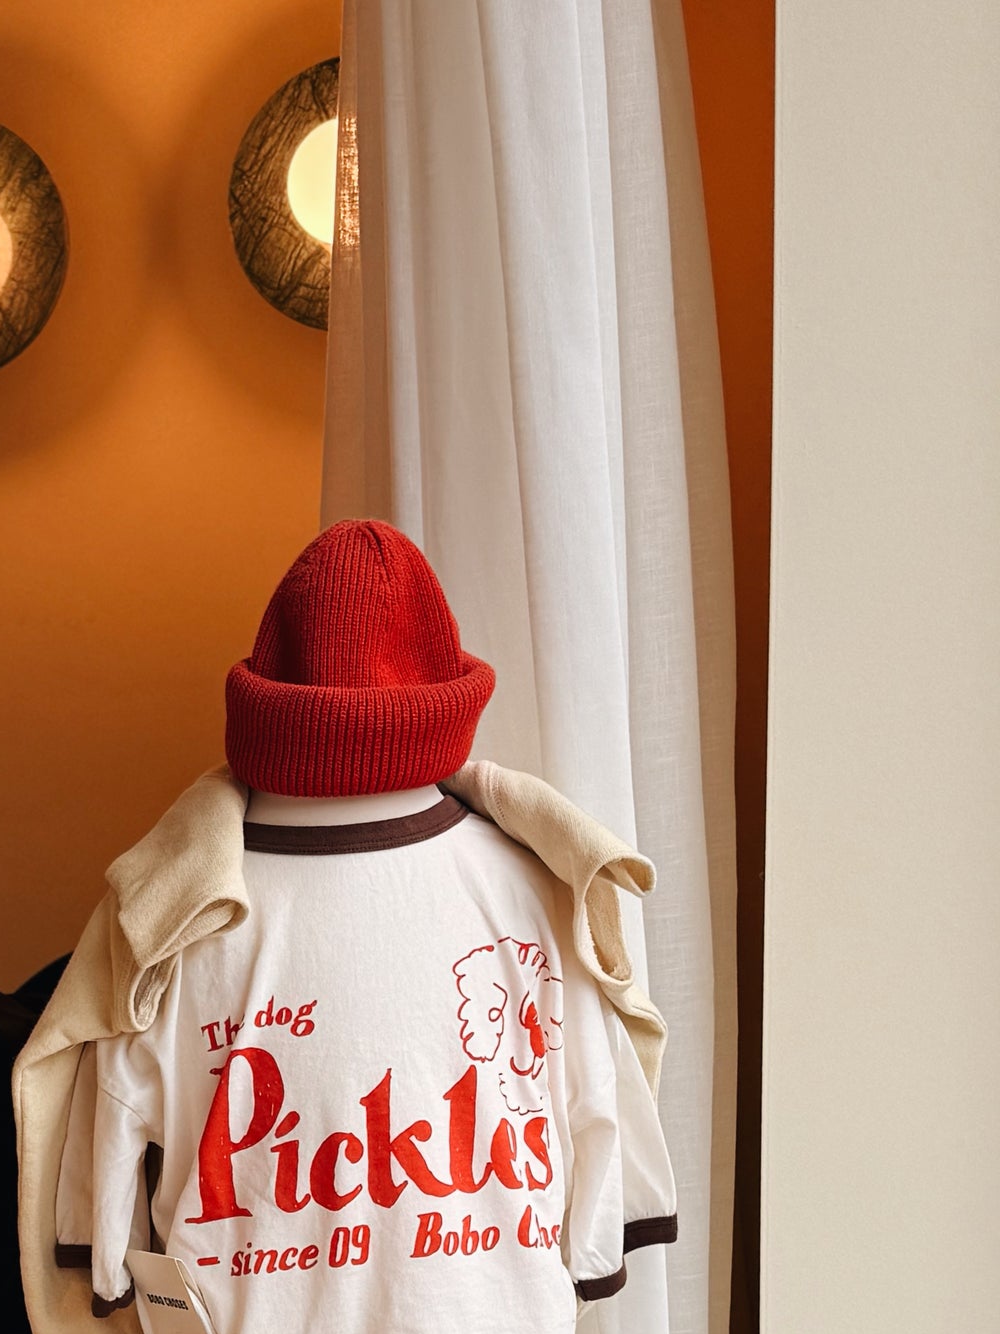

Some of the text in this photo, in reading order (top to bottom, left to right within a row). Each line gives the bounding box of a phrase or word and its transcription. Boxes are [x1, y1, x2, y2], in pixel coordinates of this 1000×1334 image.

[254, 995, 318, 1037] dog
[185, 1048, 553, 1224] Pickles
[231, 1242, 319, 1277] since
[328, 1225, 371, 1268] 09
[410, 1212, 500, 1258] Bobo
